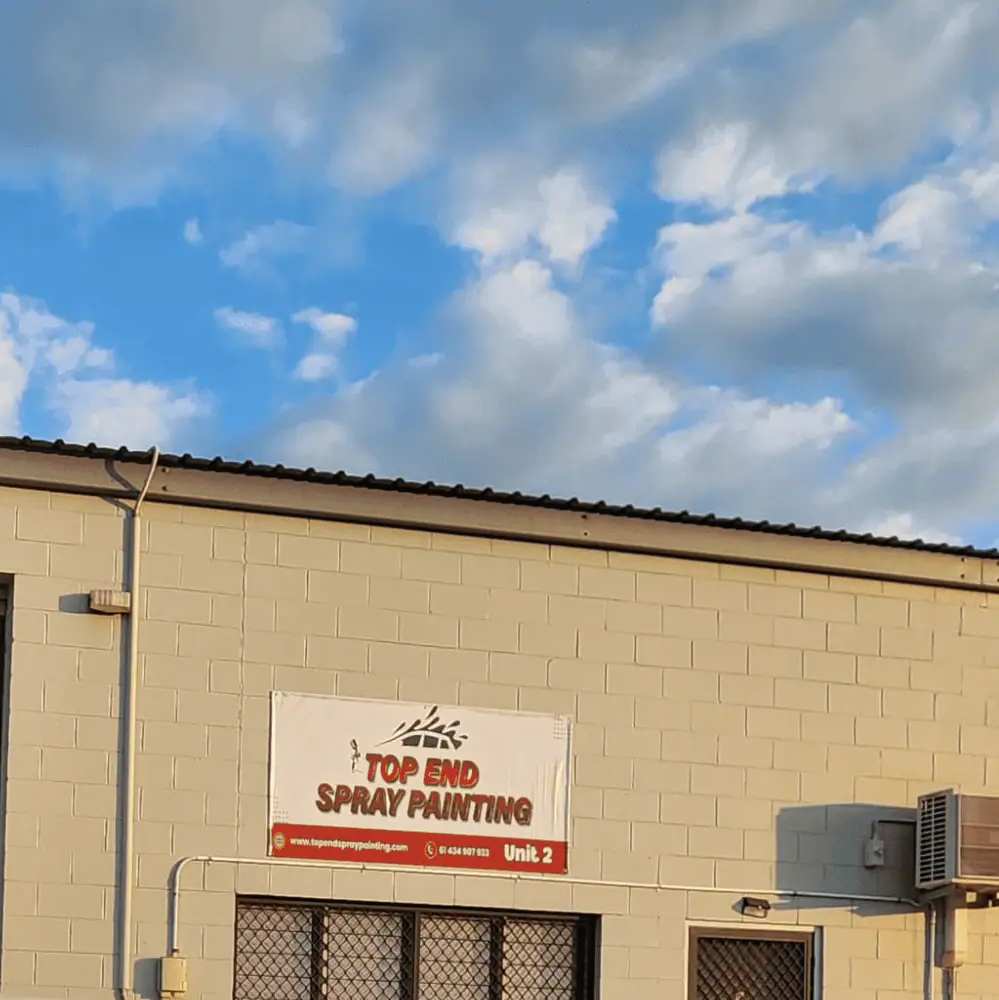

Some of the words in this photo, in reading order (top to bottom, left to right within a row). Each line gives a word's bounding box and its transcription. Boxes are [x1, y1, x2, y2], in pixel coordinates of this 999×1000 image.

[366, 753, 418, 784] TOP
[423, 758, 480, 788] END
[316, 783, 405, 817] SPRAY
[407, 790, 533, 826] PAINTING
[290, 837, 408, 853] www.topendspraypainting.com
[503, 843, 540, 863] Unit
[542, 846, 553, 864] 2
